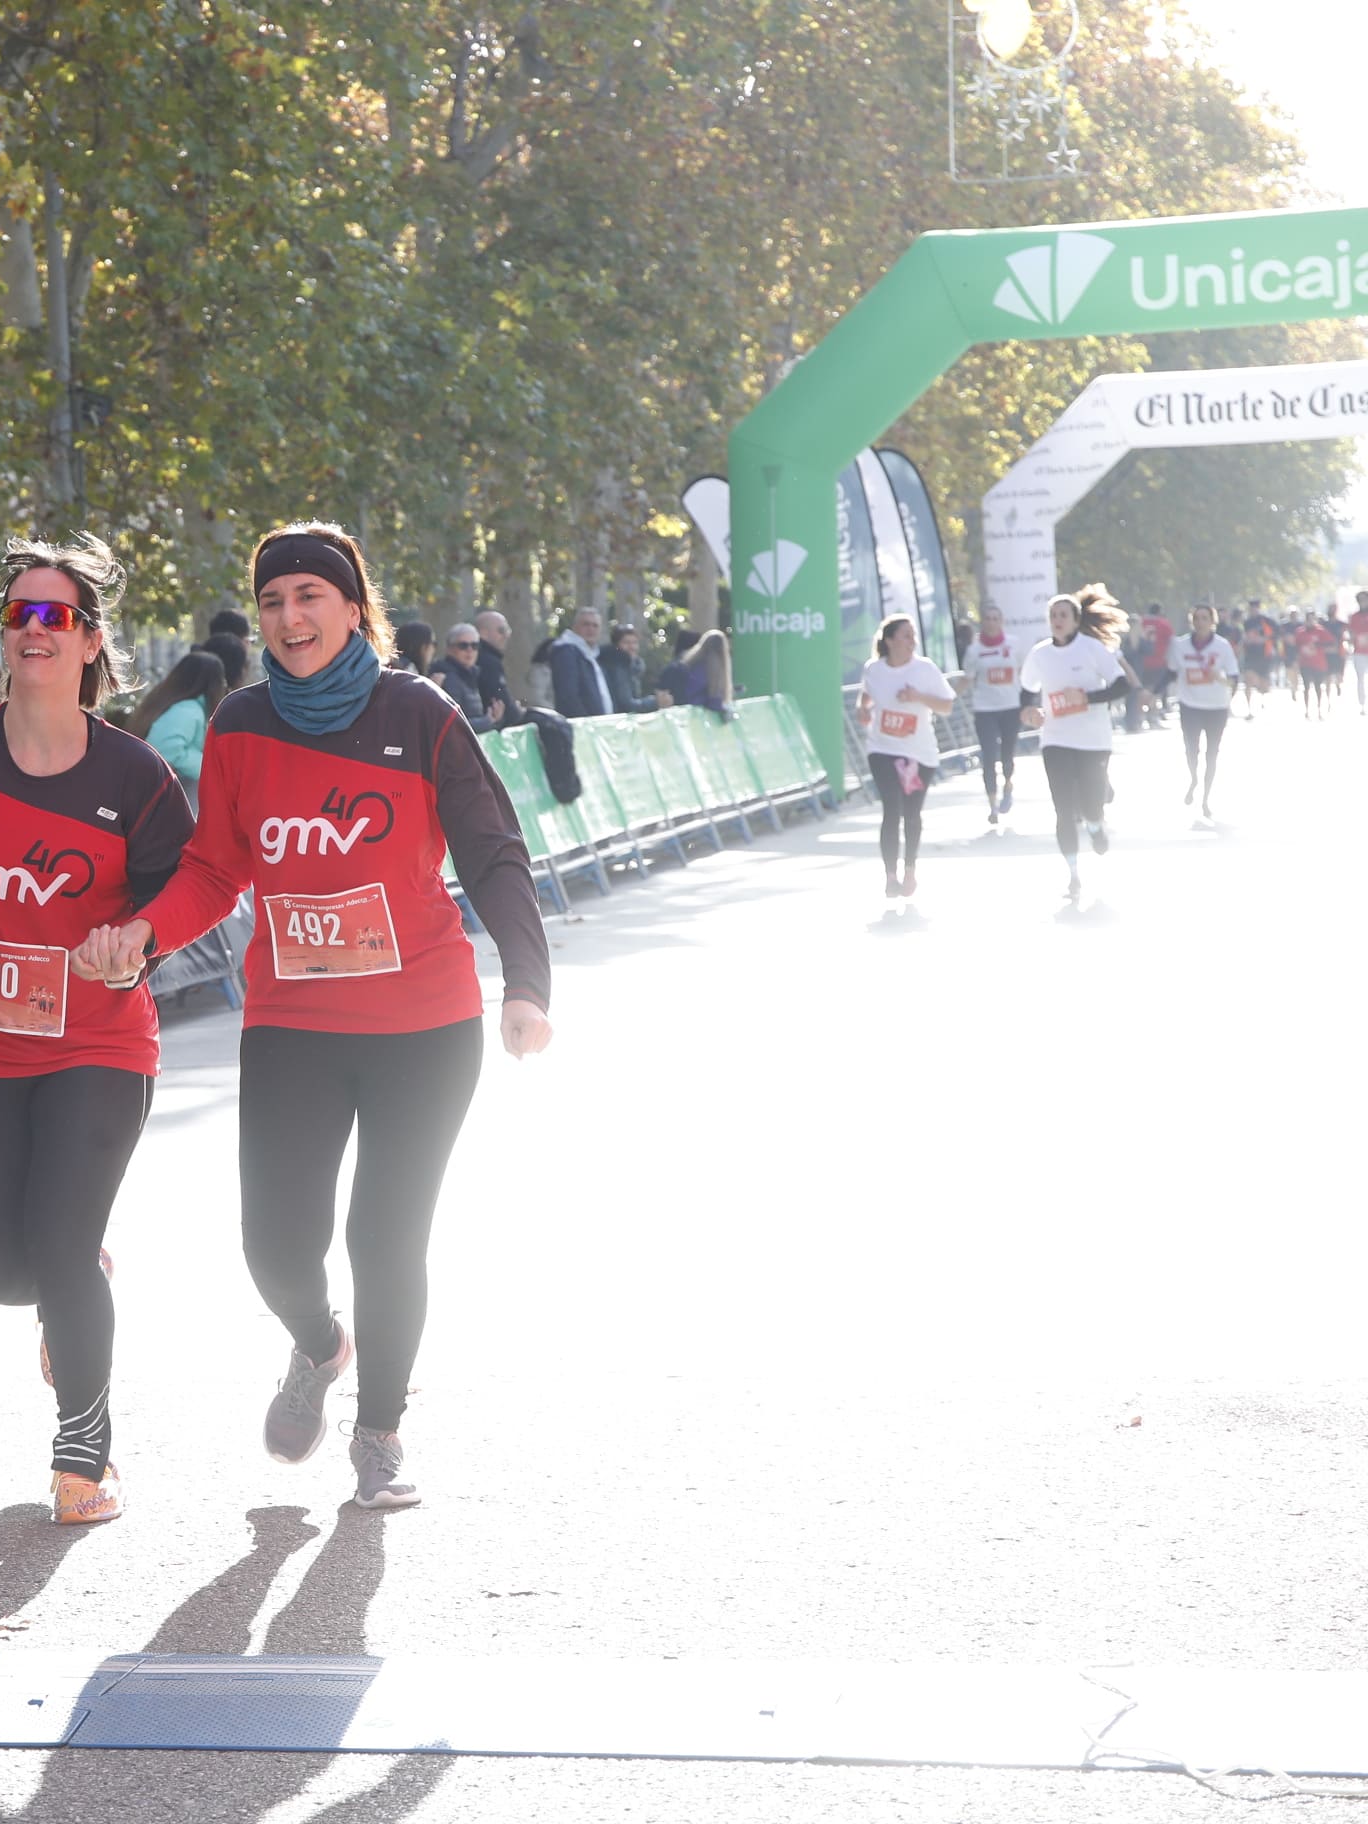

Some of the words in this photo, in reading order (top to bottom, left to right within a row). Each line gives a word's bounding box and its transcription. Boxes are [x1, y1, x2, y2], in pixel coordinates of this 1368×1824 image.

[1134, 393, 1174, 428] El
[1182, 390, 1264, 425] Norte
[1269, 389, 1301, 422] de
[735, 607, 826, 639] Unicaja
[260, 817, 371, 864] gmv
[287, 911, 345, 946] 492
